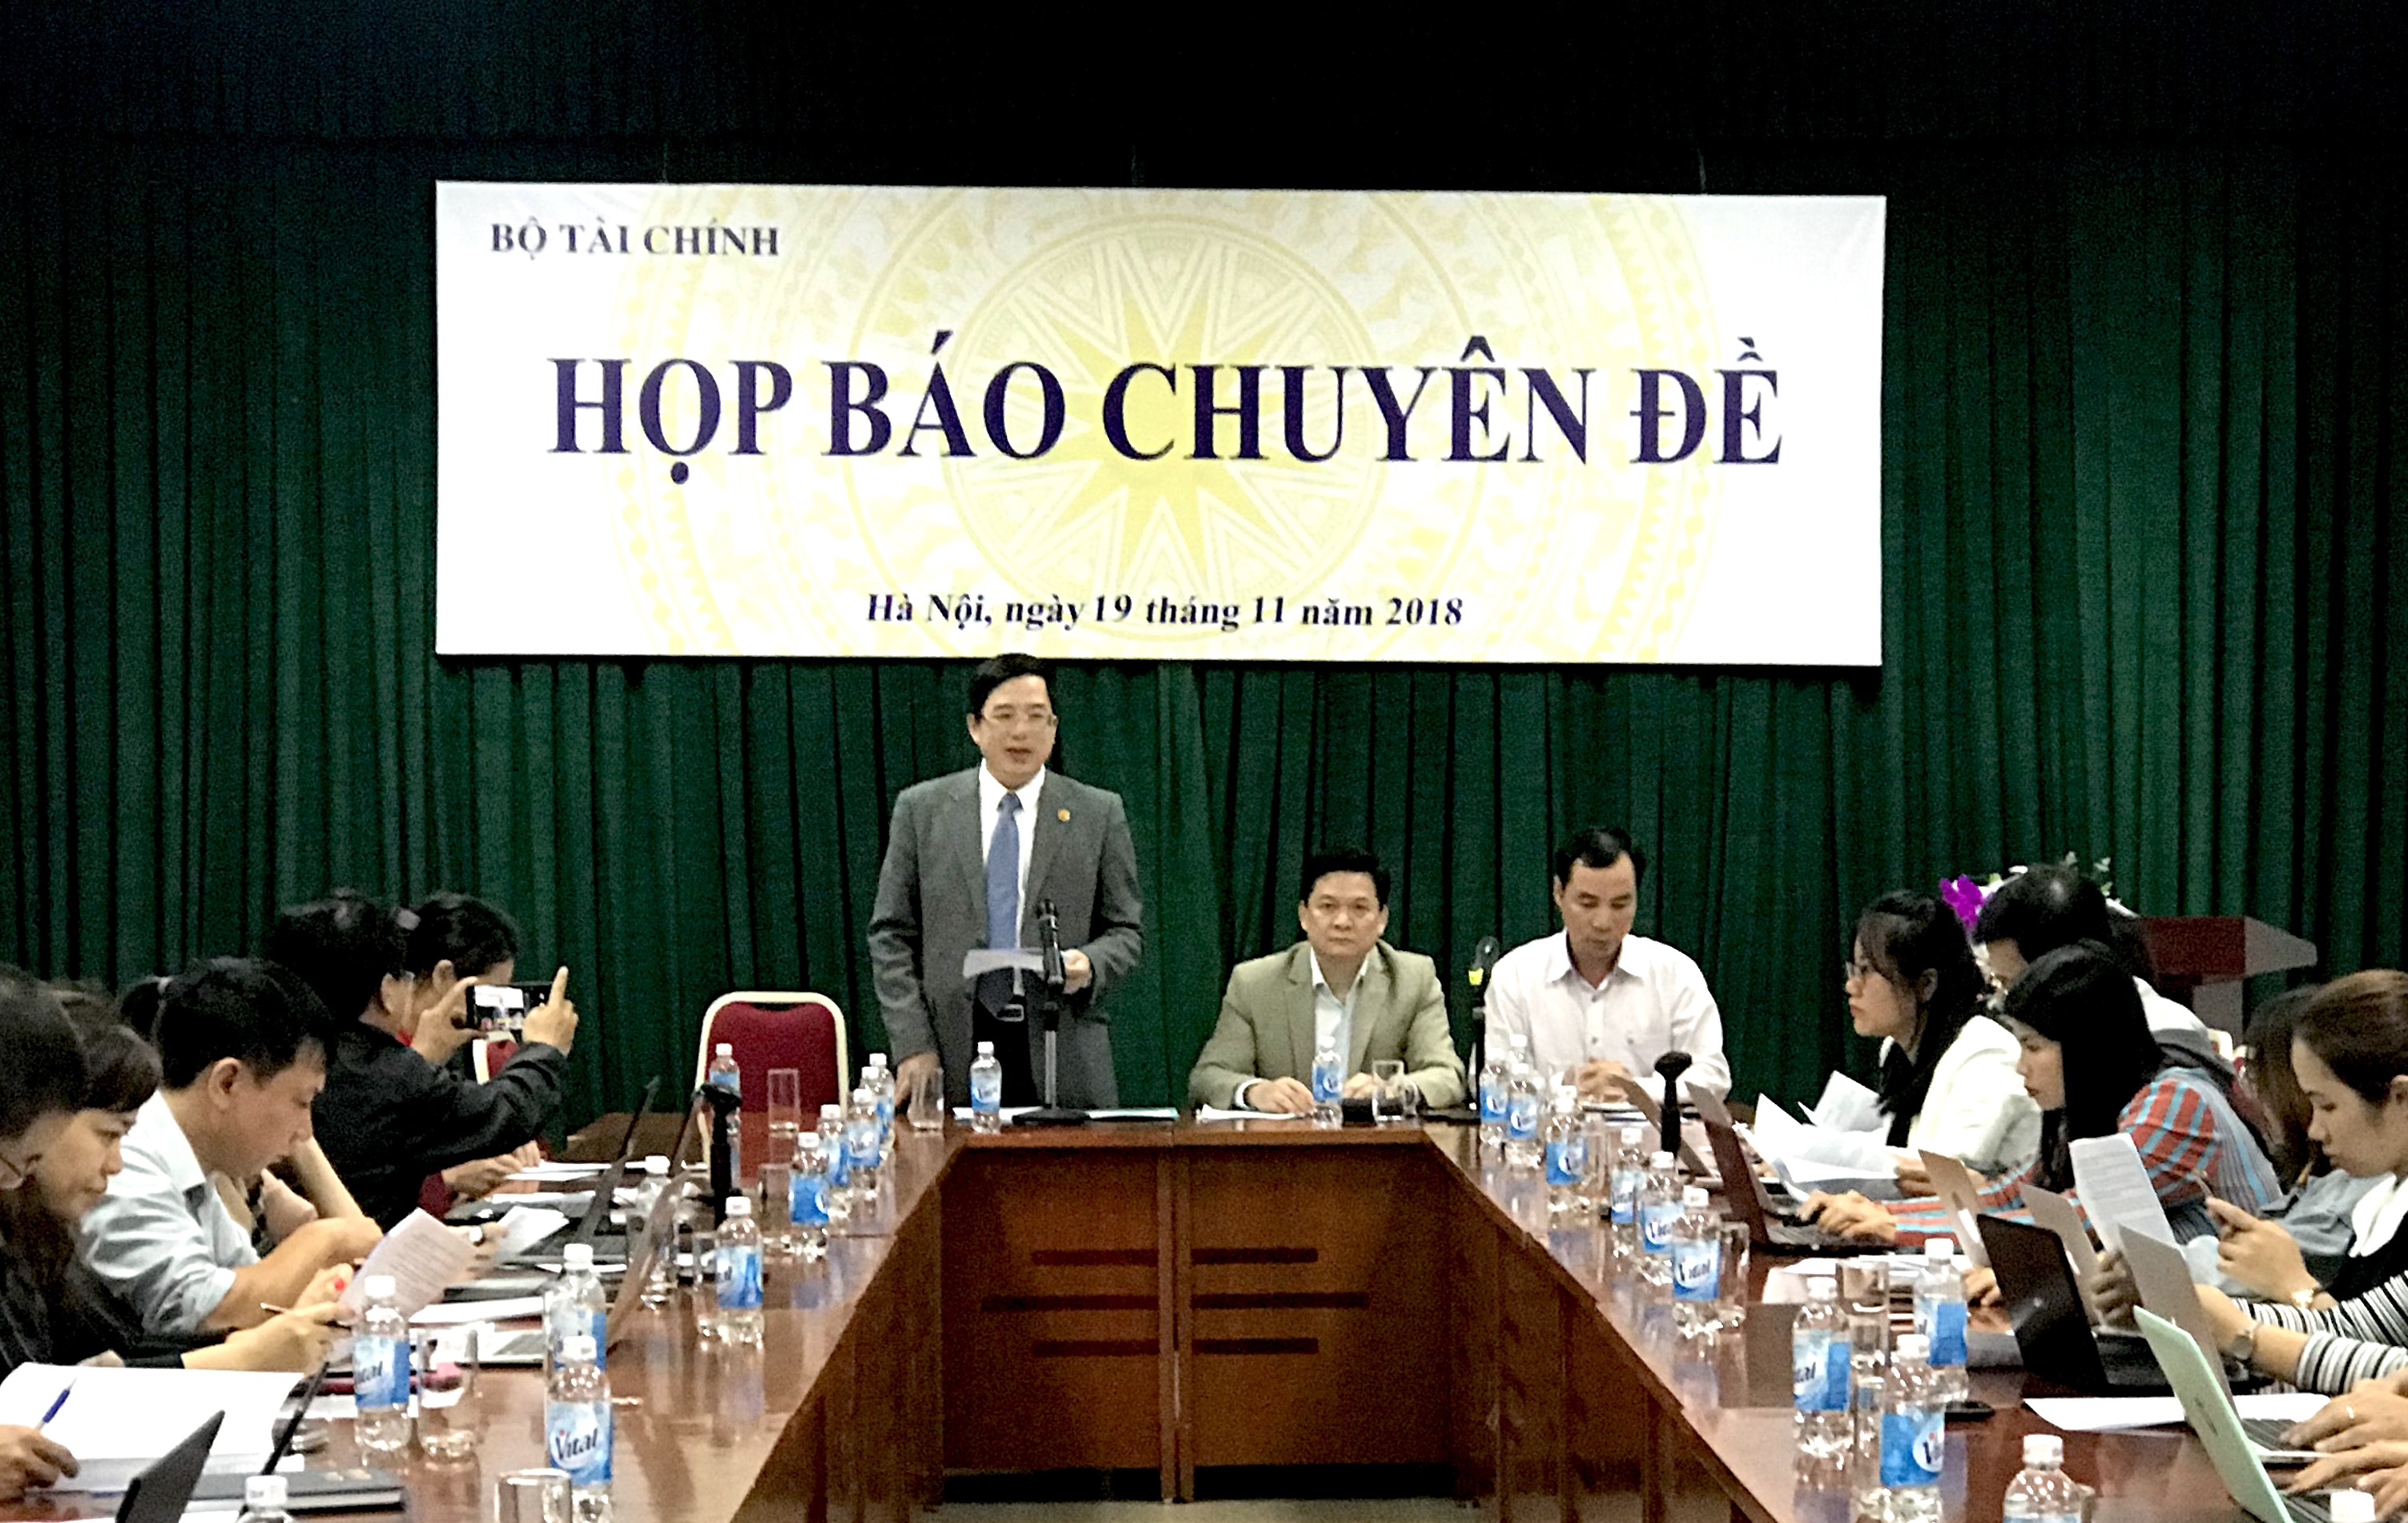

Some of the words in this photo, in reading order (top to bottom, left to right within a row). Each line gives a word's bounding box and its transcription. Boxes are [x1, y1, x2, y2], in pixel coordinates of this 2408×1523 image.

[491, 216, 547, 260] BỘ
[559, 216, 631, 254] TÀI
[643, 217, 779, 256] CHÍNH
[547, 357, 792, 485] HỌP
[821, 329, 1065, 459] BÁO
[1102, 335, 1597, 465] CHUYÊN
[1629, 336, 1782, 465] ĐỀ
[867, 593, 913, 622] Hà
[927, 593, 992, 630] Nội,
[1005, 593, 1085, 631] ngày
[1095, 594, 1133, 622] 19
[1146, 594, 1241, 632] tháng
[1253, 595, 1285, 623] 11
[1301, 597, 1374, 626] năm
[1386, 596, 1464, 626] 2018
[555, 1428, 598, 1461] Vital
